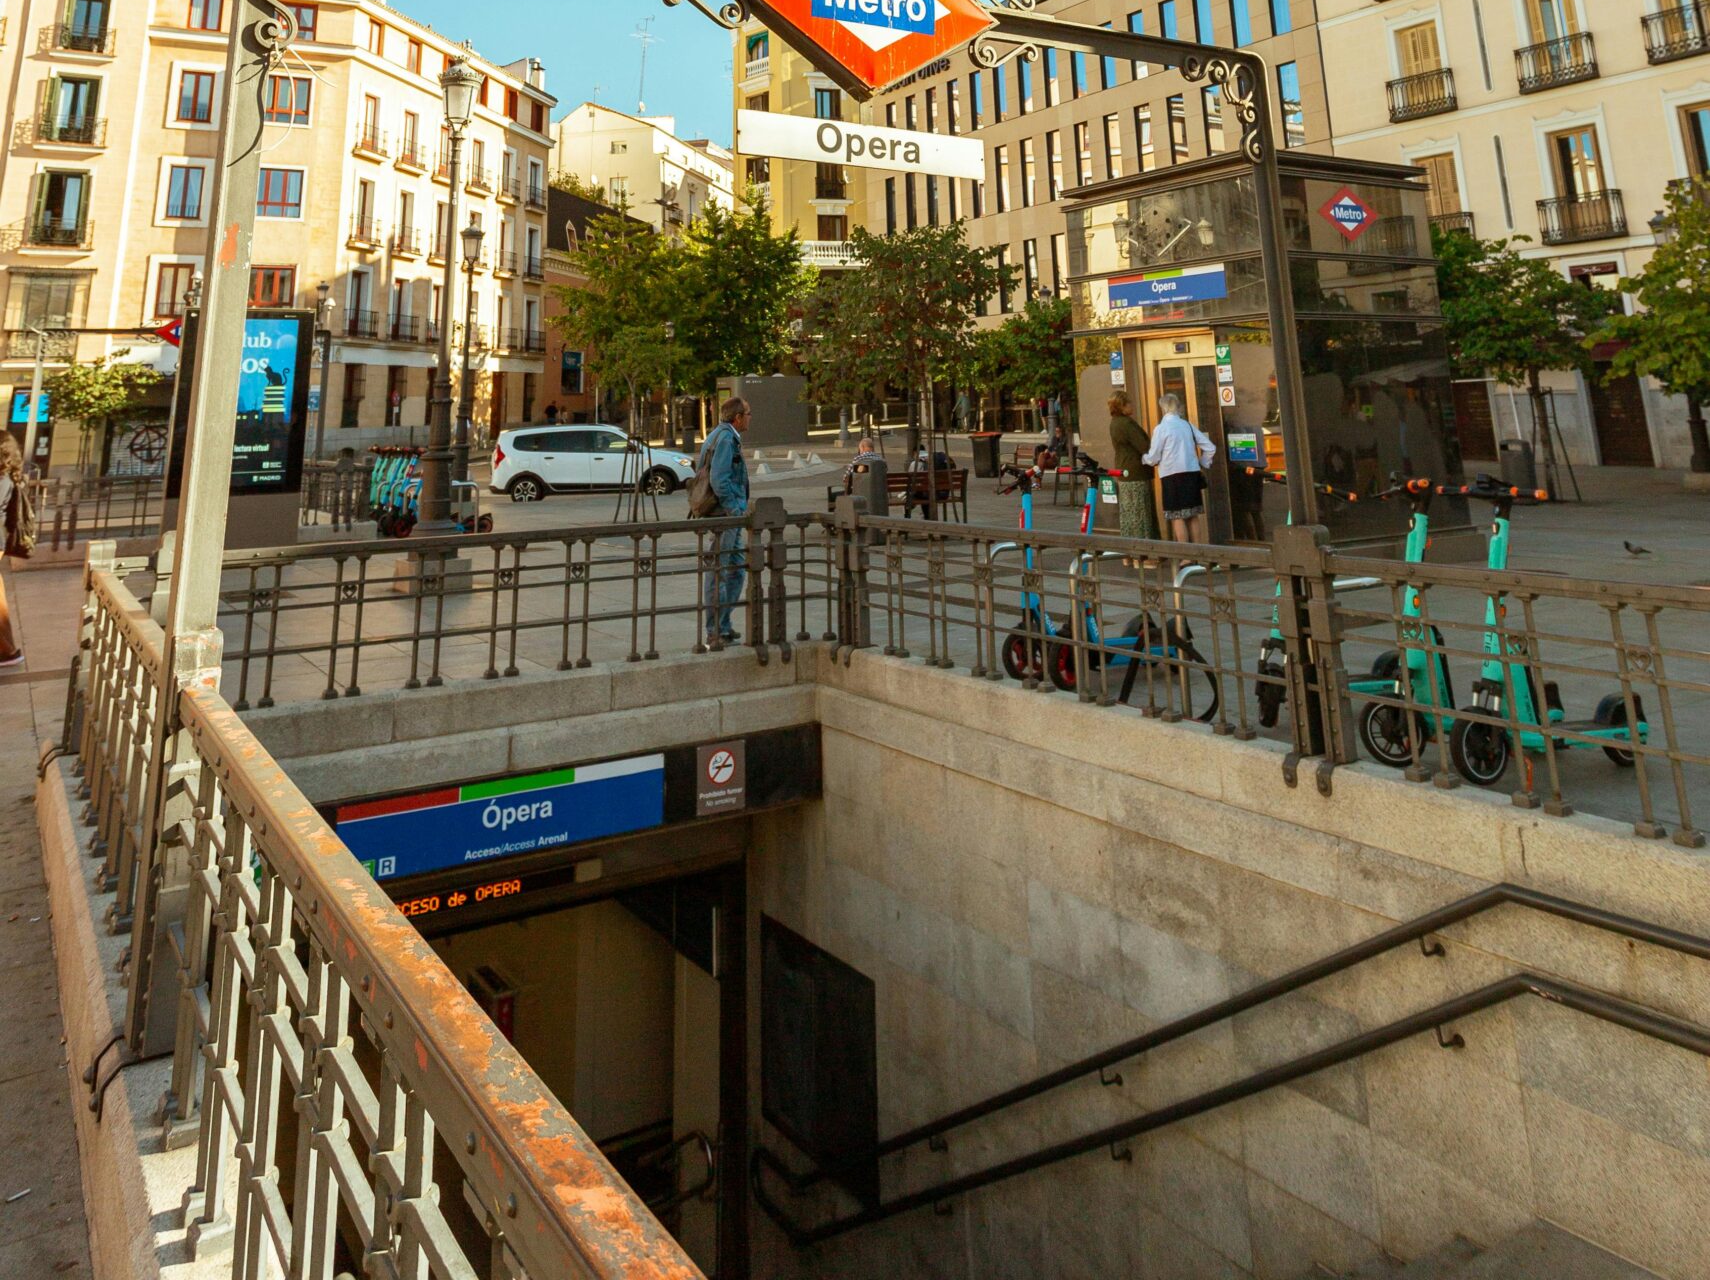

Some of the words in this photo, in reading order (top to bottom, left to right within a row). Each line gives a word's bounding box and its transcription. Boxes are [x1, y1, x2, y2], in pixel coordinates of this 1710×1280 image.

[816, 122, 921, 165] Opera
[1335, 207, 1362, 220] Metro
[1151, 279, 1177, 294] Ópera
[242, 331, 273, 349] lub
[240, 358, 270, 374] os
[482, 798, 553, 831] Ópera
[538, 831, 568, 846] Arenal
[381, 859, 394, 874] R
[447, 892, 467, 908] de
[475, 879, 522, 902] OPERA
